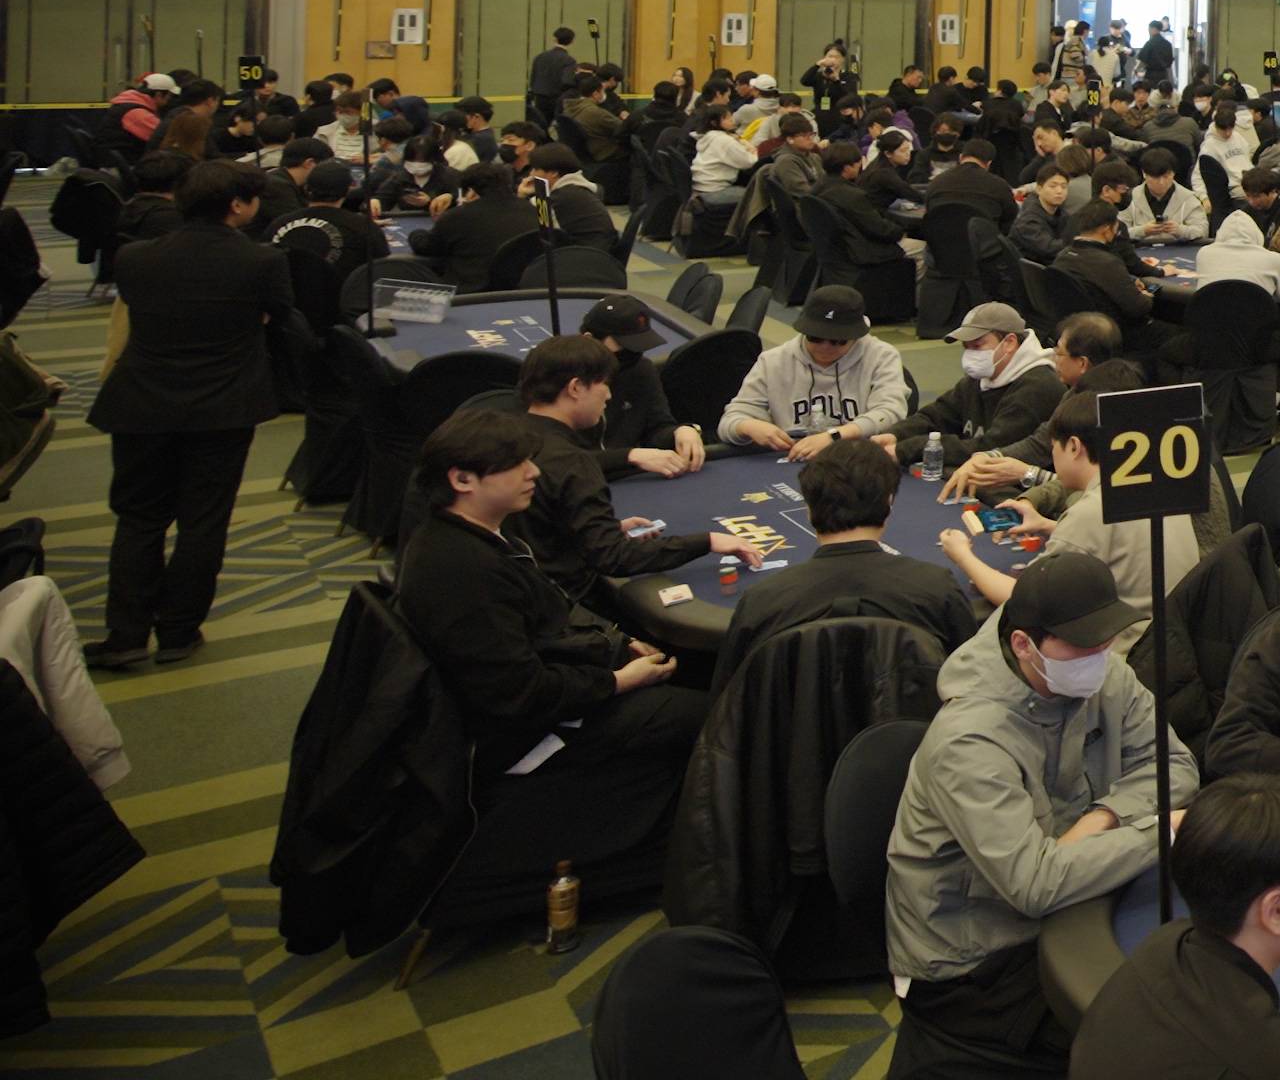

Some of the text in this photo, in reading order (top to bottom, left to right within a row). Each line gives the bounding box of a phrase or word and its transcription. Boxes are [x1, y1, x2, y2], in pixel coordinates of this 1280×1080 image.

[240, 67, 262, 80] 50
[1264, 57, 1276, 69] 48
[1088, 90, 1099, 105] 39
[536, 197, 550, 228] 30
[793, 395, 860, 425] POLO
[1110, 425, 1200, 487] 20
